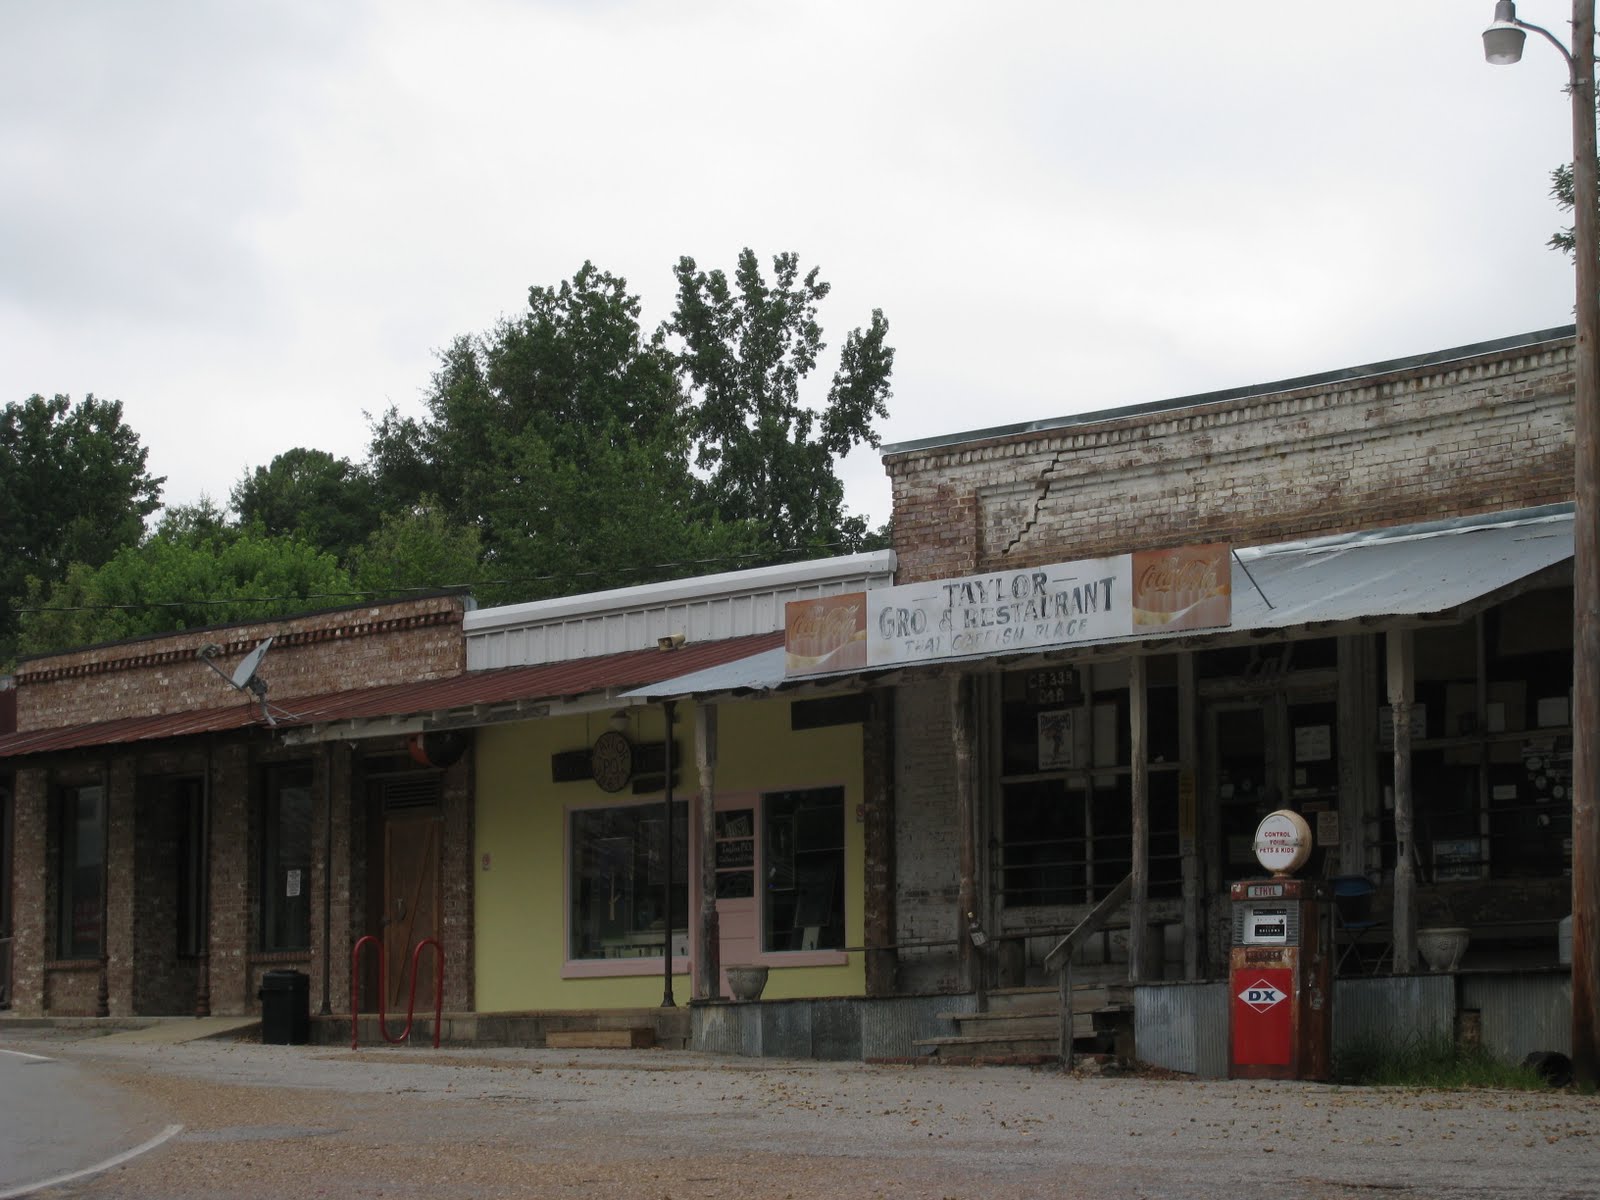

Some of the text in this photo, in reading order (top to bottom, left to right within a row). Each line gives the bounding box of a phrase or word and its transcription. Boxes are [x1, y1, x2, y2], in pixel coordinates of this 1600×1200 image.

[942, 572, 1047, 608] TAYLOR
[938, 608, 952, 632] &
[963, 576, 1117, 629] RESTAURANT
[1035, 618, 1088, 640] PLACE
[1254, 887, 1277, 896] ETHYL
[1248, 991, 1276, 1001] DX
